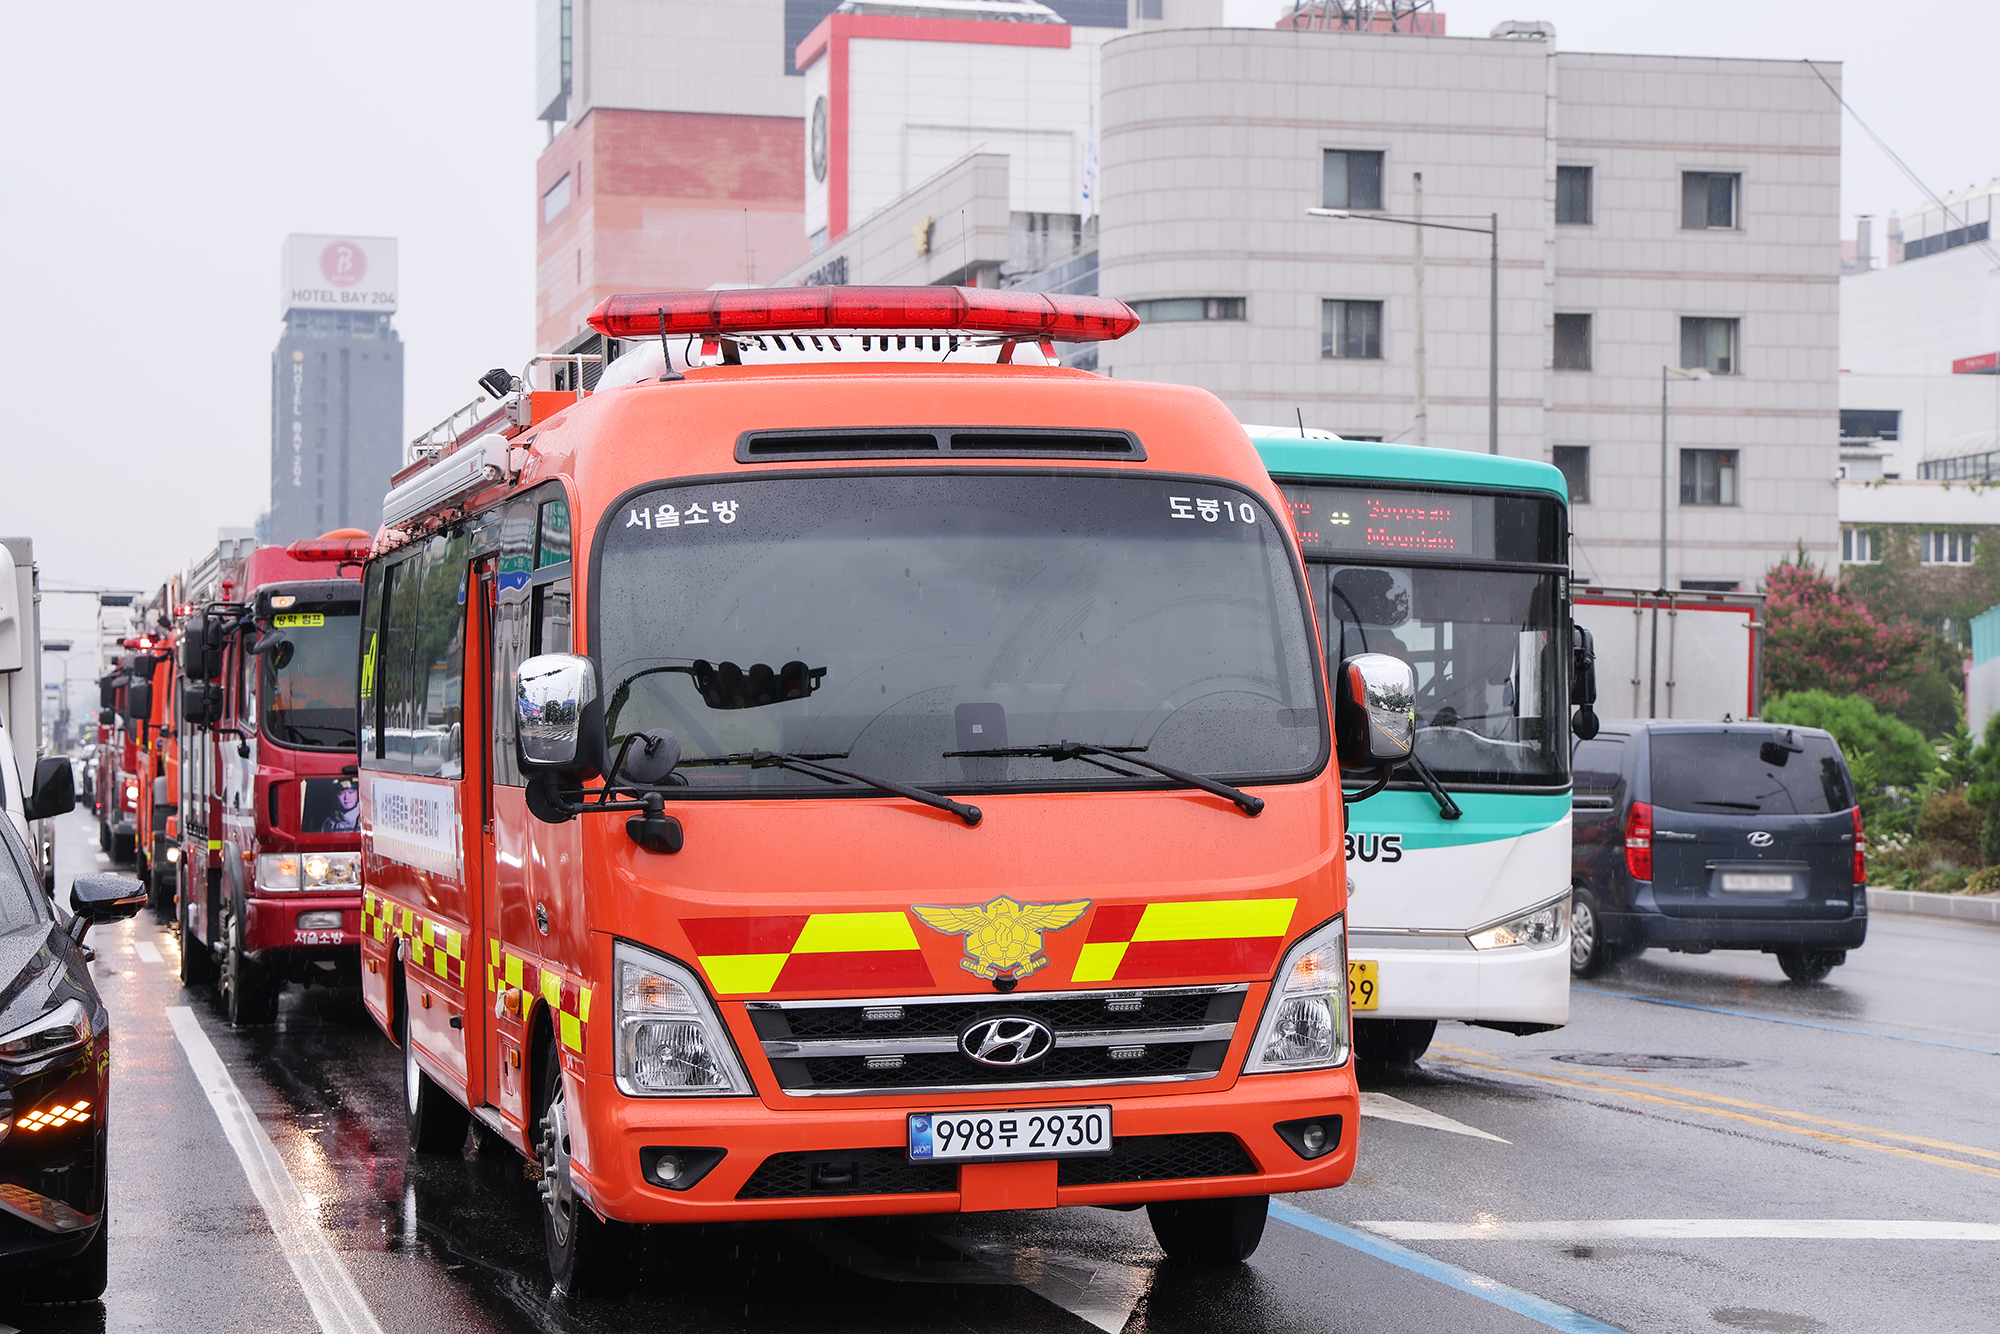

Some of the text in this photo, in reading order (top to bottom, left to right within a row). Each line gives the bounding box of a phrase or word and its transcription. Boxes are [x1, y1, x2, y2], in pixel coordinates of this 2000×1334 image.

[291, 288, 396, 305] HOTEL BAY 204
[625, 500, 740, 530] 서울소방
[1169, 496, 1256, 524] 도봉10
[1343, 833, 1402, 863] BUS
[294, 931, 344, 945] 서울소방
[936, 1113, 1103, 1152] 998무 2930
